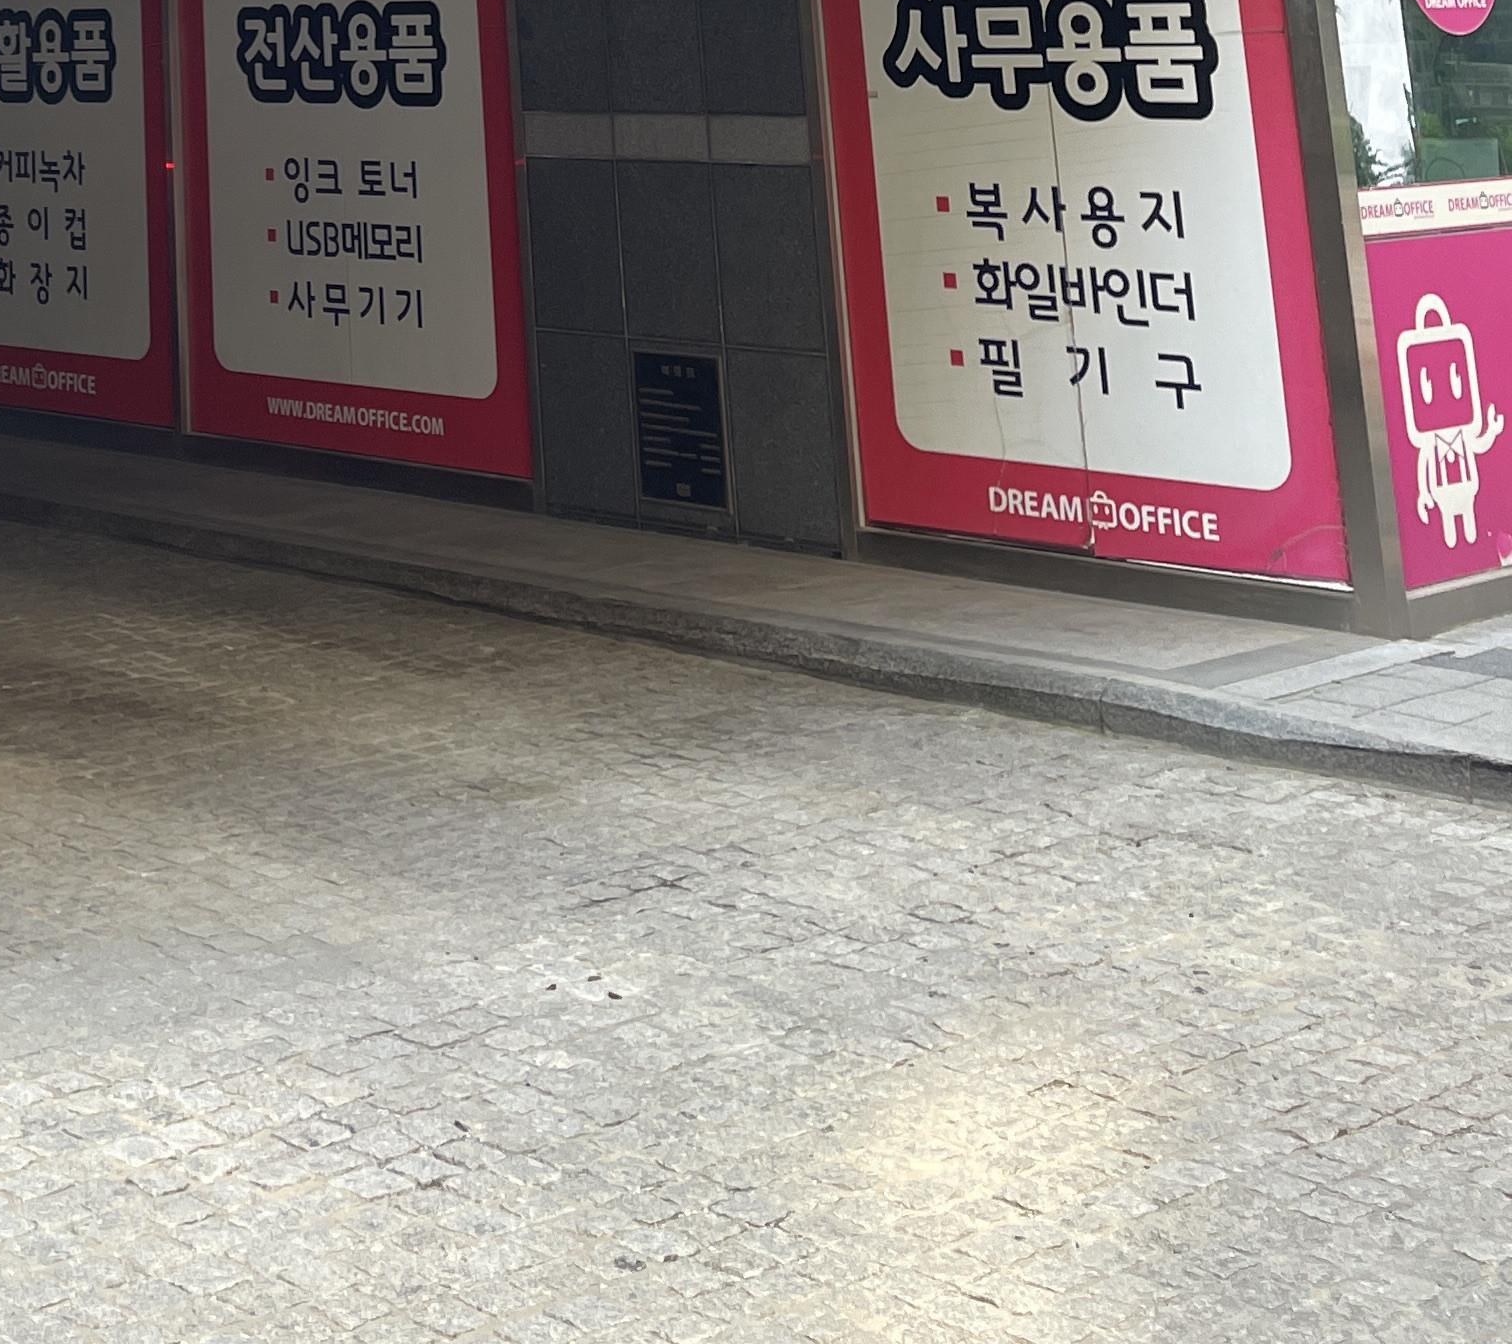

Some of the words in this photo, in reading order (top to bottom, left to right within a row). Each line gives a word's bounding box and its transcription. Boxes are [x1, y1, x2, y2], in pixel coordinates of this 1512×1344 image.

[241, 7, 442, 102] 전산용품
[283, 156, 343, 204] 잉크
[357, 158, 419, 200] 토너
[1447, 195, 1479, 213] DREAM
[1489, 192, 1512, 210] OFFIC
[965, 182, 1187, 249] 복사용지
[1360, 203, 1394, 221] DREAM
[1403, 199, 1434, 217] OFFICE
[286, 219, 423, 264] USB메모리
[287, 280, 425, 329] 사무기기
[972, 257, 1197, 328] 화일바인더
[48, 370, 97, 395] OFFICE
[266, 395, 445, 437] WWW.DREAMOFFICE.COM
[988, 485, 1084, 524] DREAM
[1117, 502, 1221, 542] OFFICE
